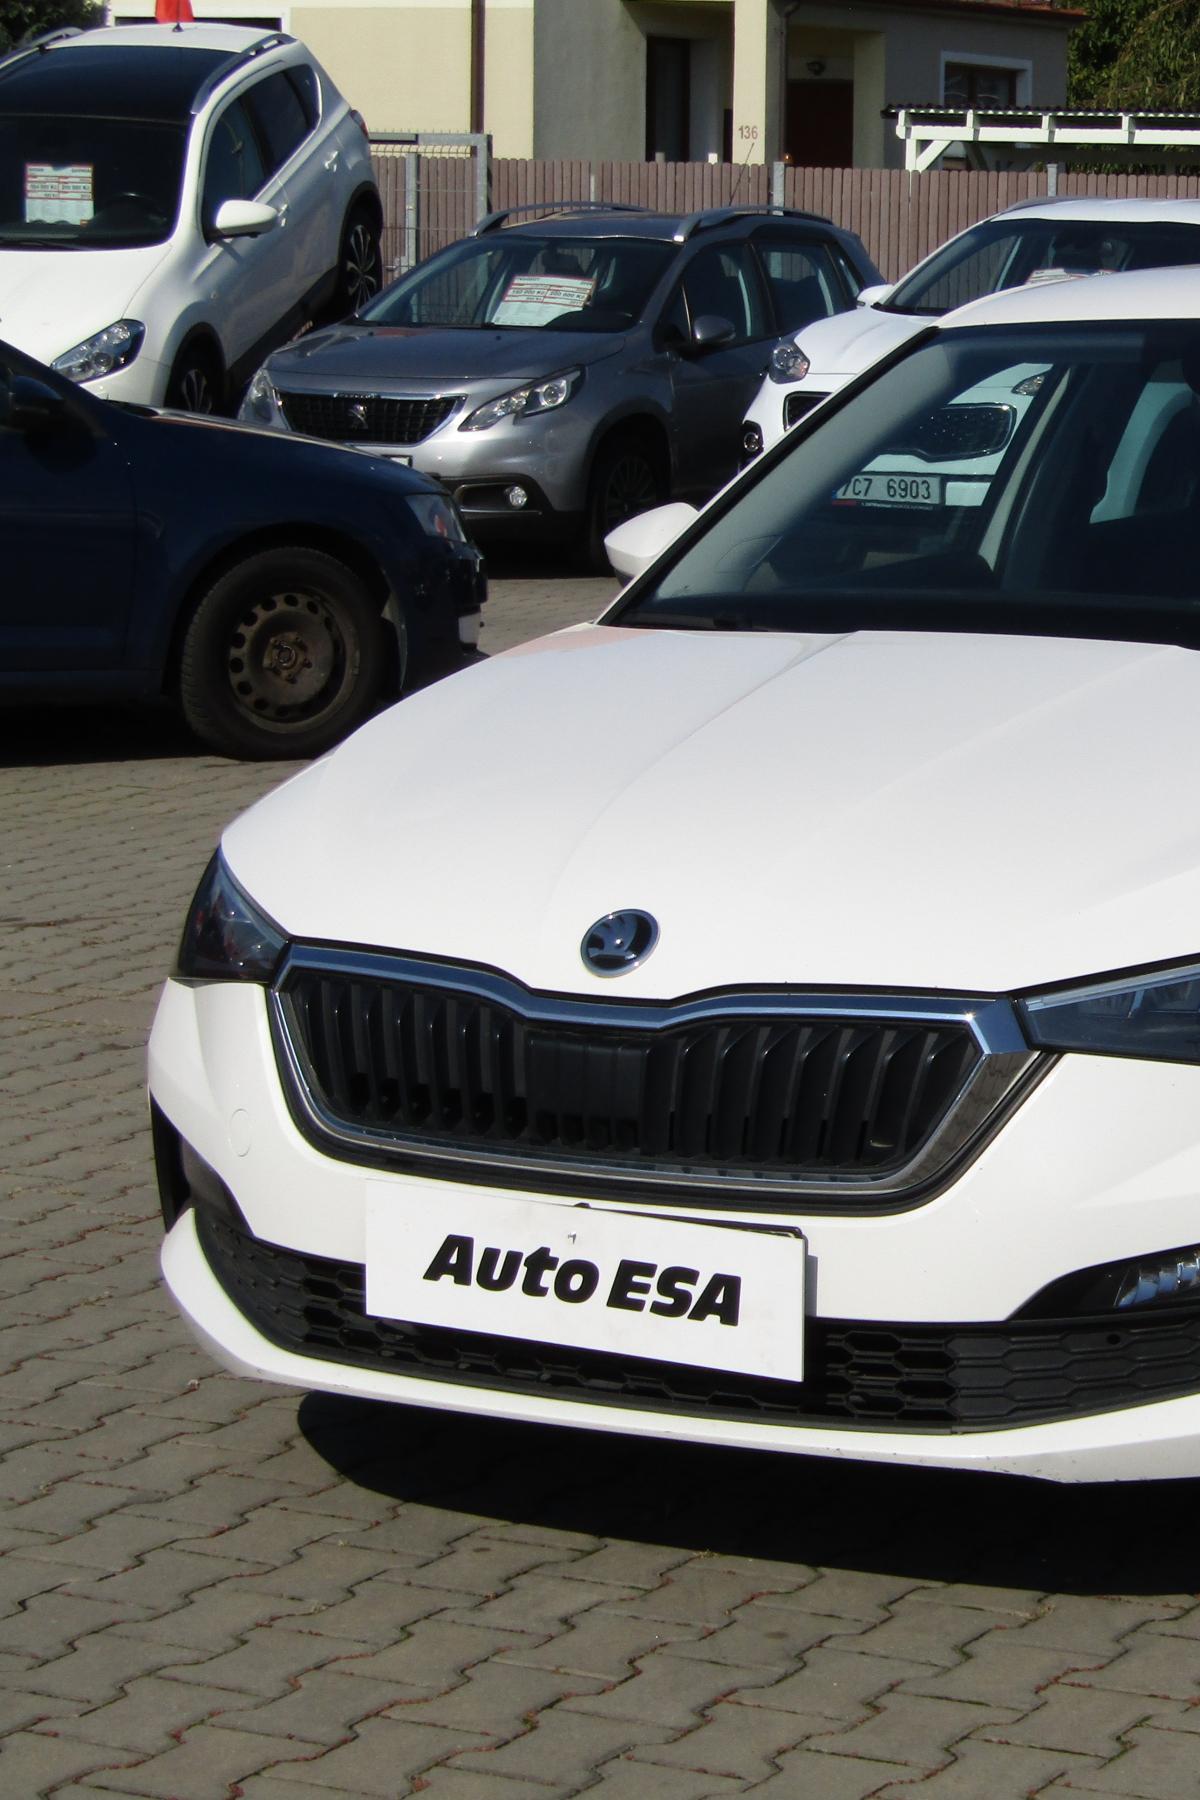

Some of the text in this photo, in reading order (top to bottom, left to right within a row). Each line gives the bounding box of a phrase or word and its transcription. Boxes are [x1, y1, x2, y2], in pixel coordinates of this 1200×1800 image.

[738, 124, 759, 140] 136
[886, 478, 931, 500] 6903
[422, 1233, 742, 1327] Auto ESA
